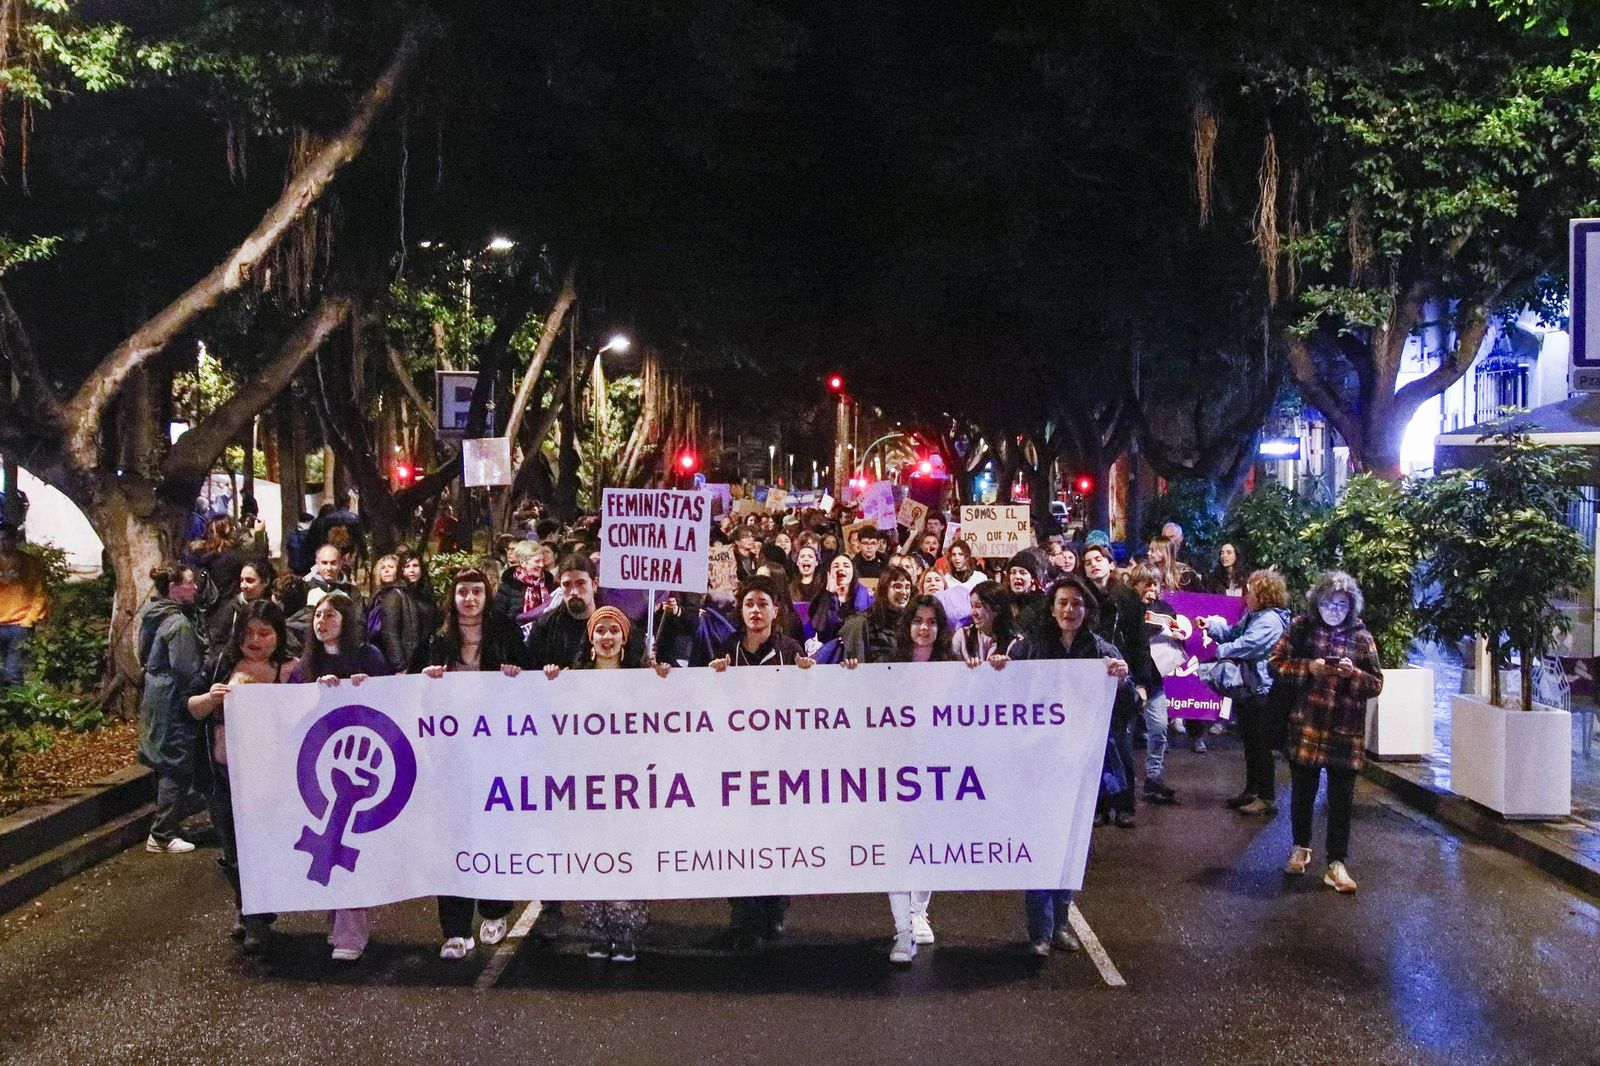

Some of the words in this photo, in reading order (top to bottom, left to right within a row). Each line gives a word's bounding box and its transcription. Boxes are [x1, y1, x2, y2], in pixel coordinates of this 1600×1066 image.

[607, 492, 704, 522] FEMINISTAS
[965, 508, 997, 521] SOMOS
[1005, 508, 1017, 519] EL
[608, 523, 667, 548] CONTRA
[674, 526, 696, 552] LA
[987, 531, 1002, 541] QUE
[1007, 531, 1018, 541] YA
[1018, 521, 1027, 531] DE
[621, 554, 682, 584] GUERRA
[418, 715, 458, 738] NO
[473, 715, 491, 737] A
[507, 714, 538, 736] LA
[552, 711, 714, 736] VIOLENCIA
[728, 708, 851, 732] CONTRA
[866, 706, 916, 728] LAS
[933, 703, 1065, 727] MUJERES
[484, 764, 696, 812] ALMERÍA
[721, 766, 986, 807] FEMINISTA
[456, 851, 633, 875] COLECTIVOS
[658, 846, 826, 872] FEMINISTAS
[850, 844, 886, 867] DE
[909, 837, 1032, 865] ALMERÍA
